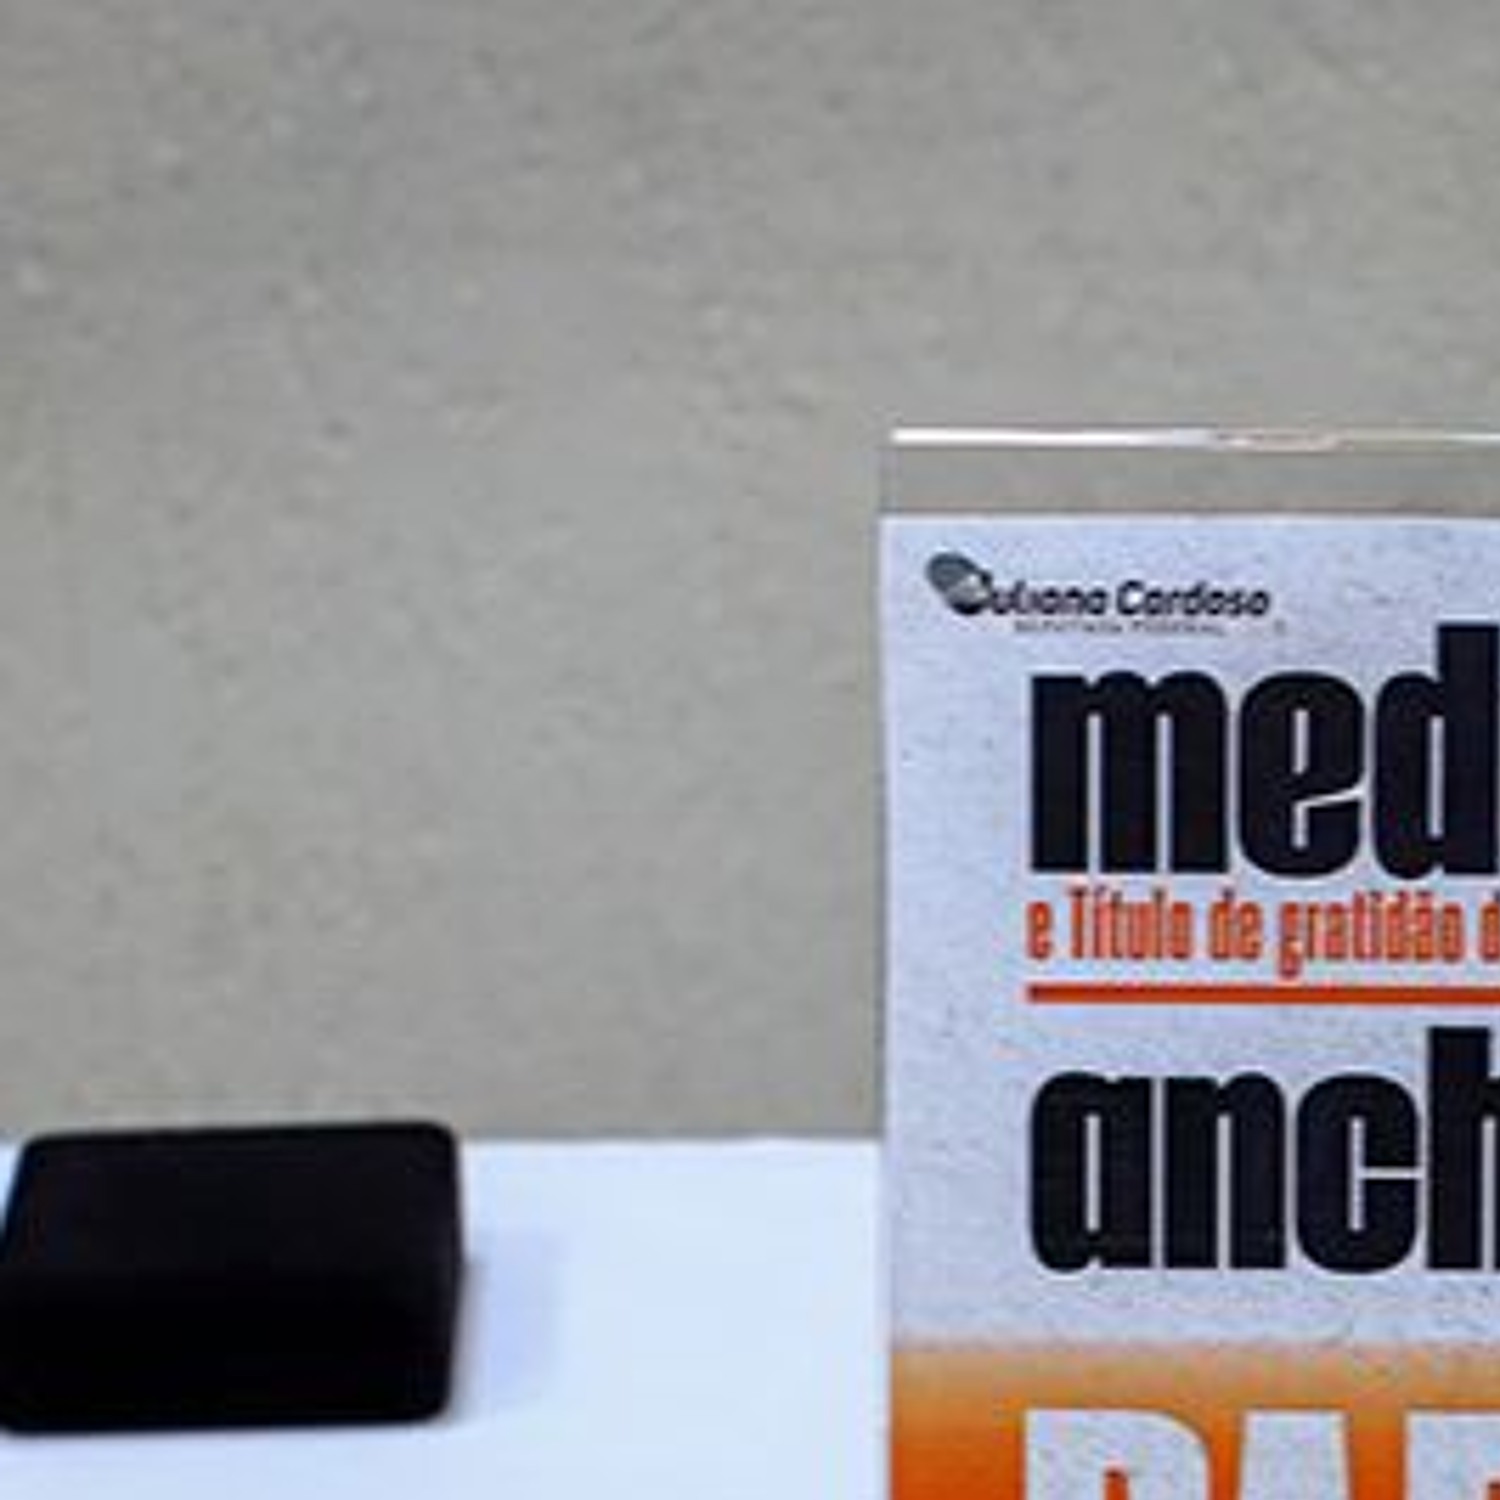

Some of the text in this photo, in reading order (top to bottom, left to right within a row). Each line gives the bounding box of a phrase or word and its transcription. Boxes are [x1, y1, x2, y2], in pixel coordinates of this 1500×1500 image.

[1116, 579, 1271, 617] Cardoso
[1027, 899, 1054, 961] e
[1210, 888, 1264, 961] de
[1276, 888, 1465, 979] gratidão
